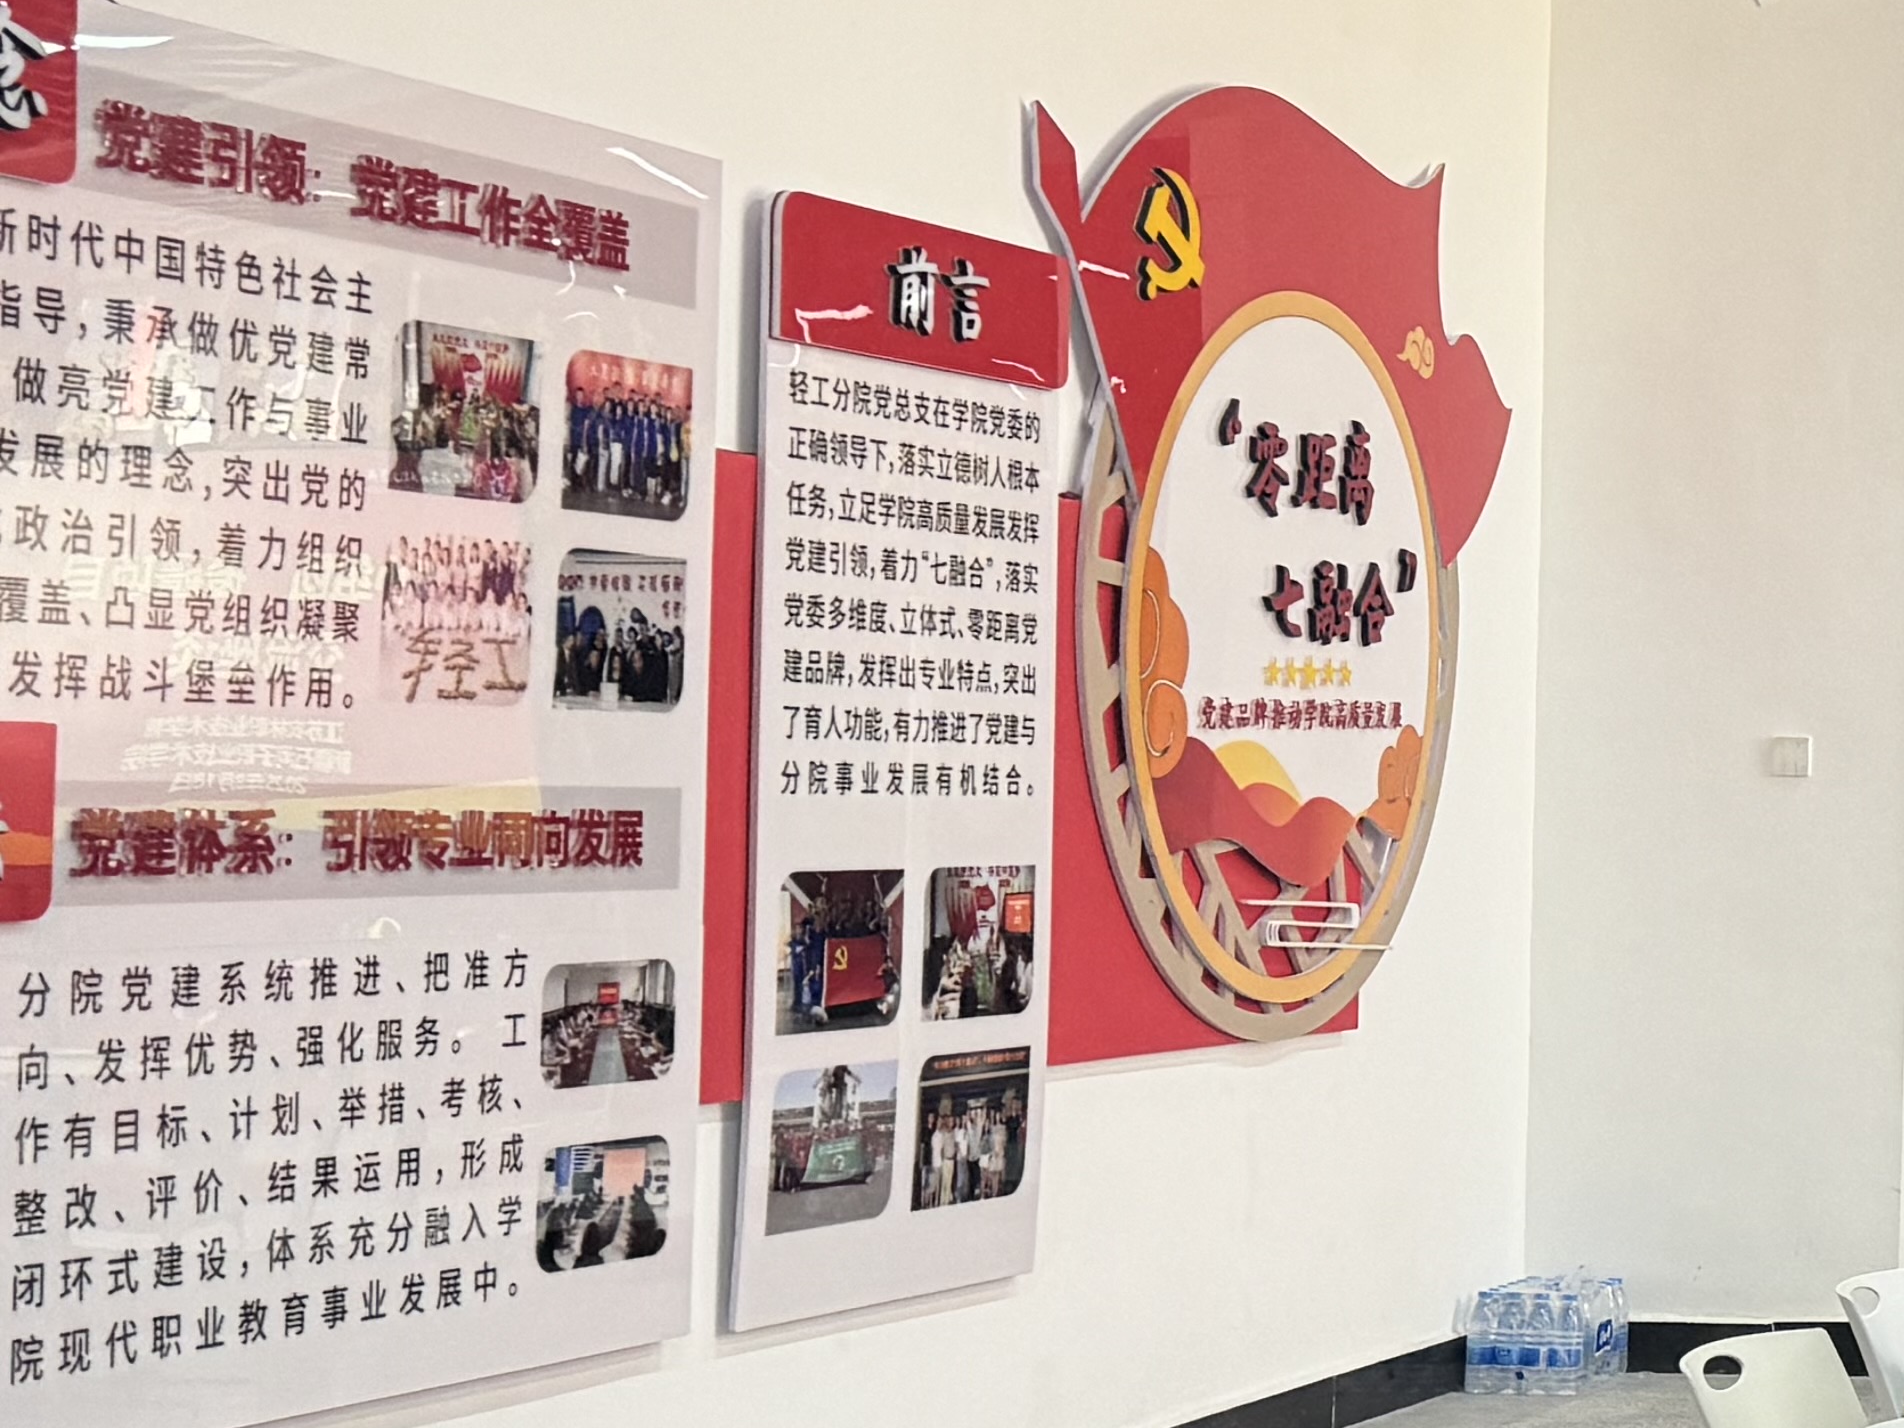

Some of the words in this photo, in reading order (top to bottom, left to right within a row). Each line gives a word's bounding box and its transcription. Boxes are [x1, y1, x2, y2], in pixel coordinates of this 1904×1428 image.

[94, 98, 630, 271] 党建引领：党建工作全覆盖
[885, 245, 989, 343] 前言
[13, 356, 368, 445] 做亮党建工作与事业
[787, 369, 1040, 443] 轻工分院党总支在学院党委的
[0, 428, 366, 511] 发展的理念，突出党的
[788, 426, 1040, 494] 正确领导下，落实立德树人根本
[0, 505, 363, 579] 政治引领，着力组织
[787, 481, 1039, 544] 任务，立足学院高质量发展发挥
[0, 576, 359, 643] 覆盖、凸显党组织凝聚
[784, 593, 1038, 646] 党委多维度、立体式、零距离党
[8, 650, 353, 710] 发挥战斗堡垒作用。
[783, 650, 1037, 696] 建品牌，发挥出专业特点，突出
[783, 705, 1036, 747] 了育人功能，有力推进了党建与
[1196, 696, 1403, 733] 党建品牌推动学院高质量发展
[781, 760, 1034, 797] 分院事业发展有机结合。
[17, 947, 529, 1019] 分院党建系统推进、把准方
[16, 1013, 528, 1091] 向、发挥优势、强化服务。工
[14, 1073, 525, 1166] 作有目标、计划、举措、考核、
[13, 1133, 524, 1238] 整改、评价、结果运用，形成
[11, 1194, 523, 1310] 闭环式建设，体系充分融入学
[9, 1260, 520, 1385] 院现代职业教育事业发展中。
